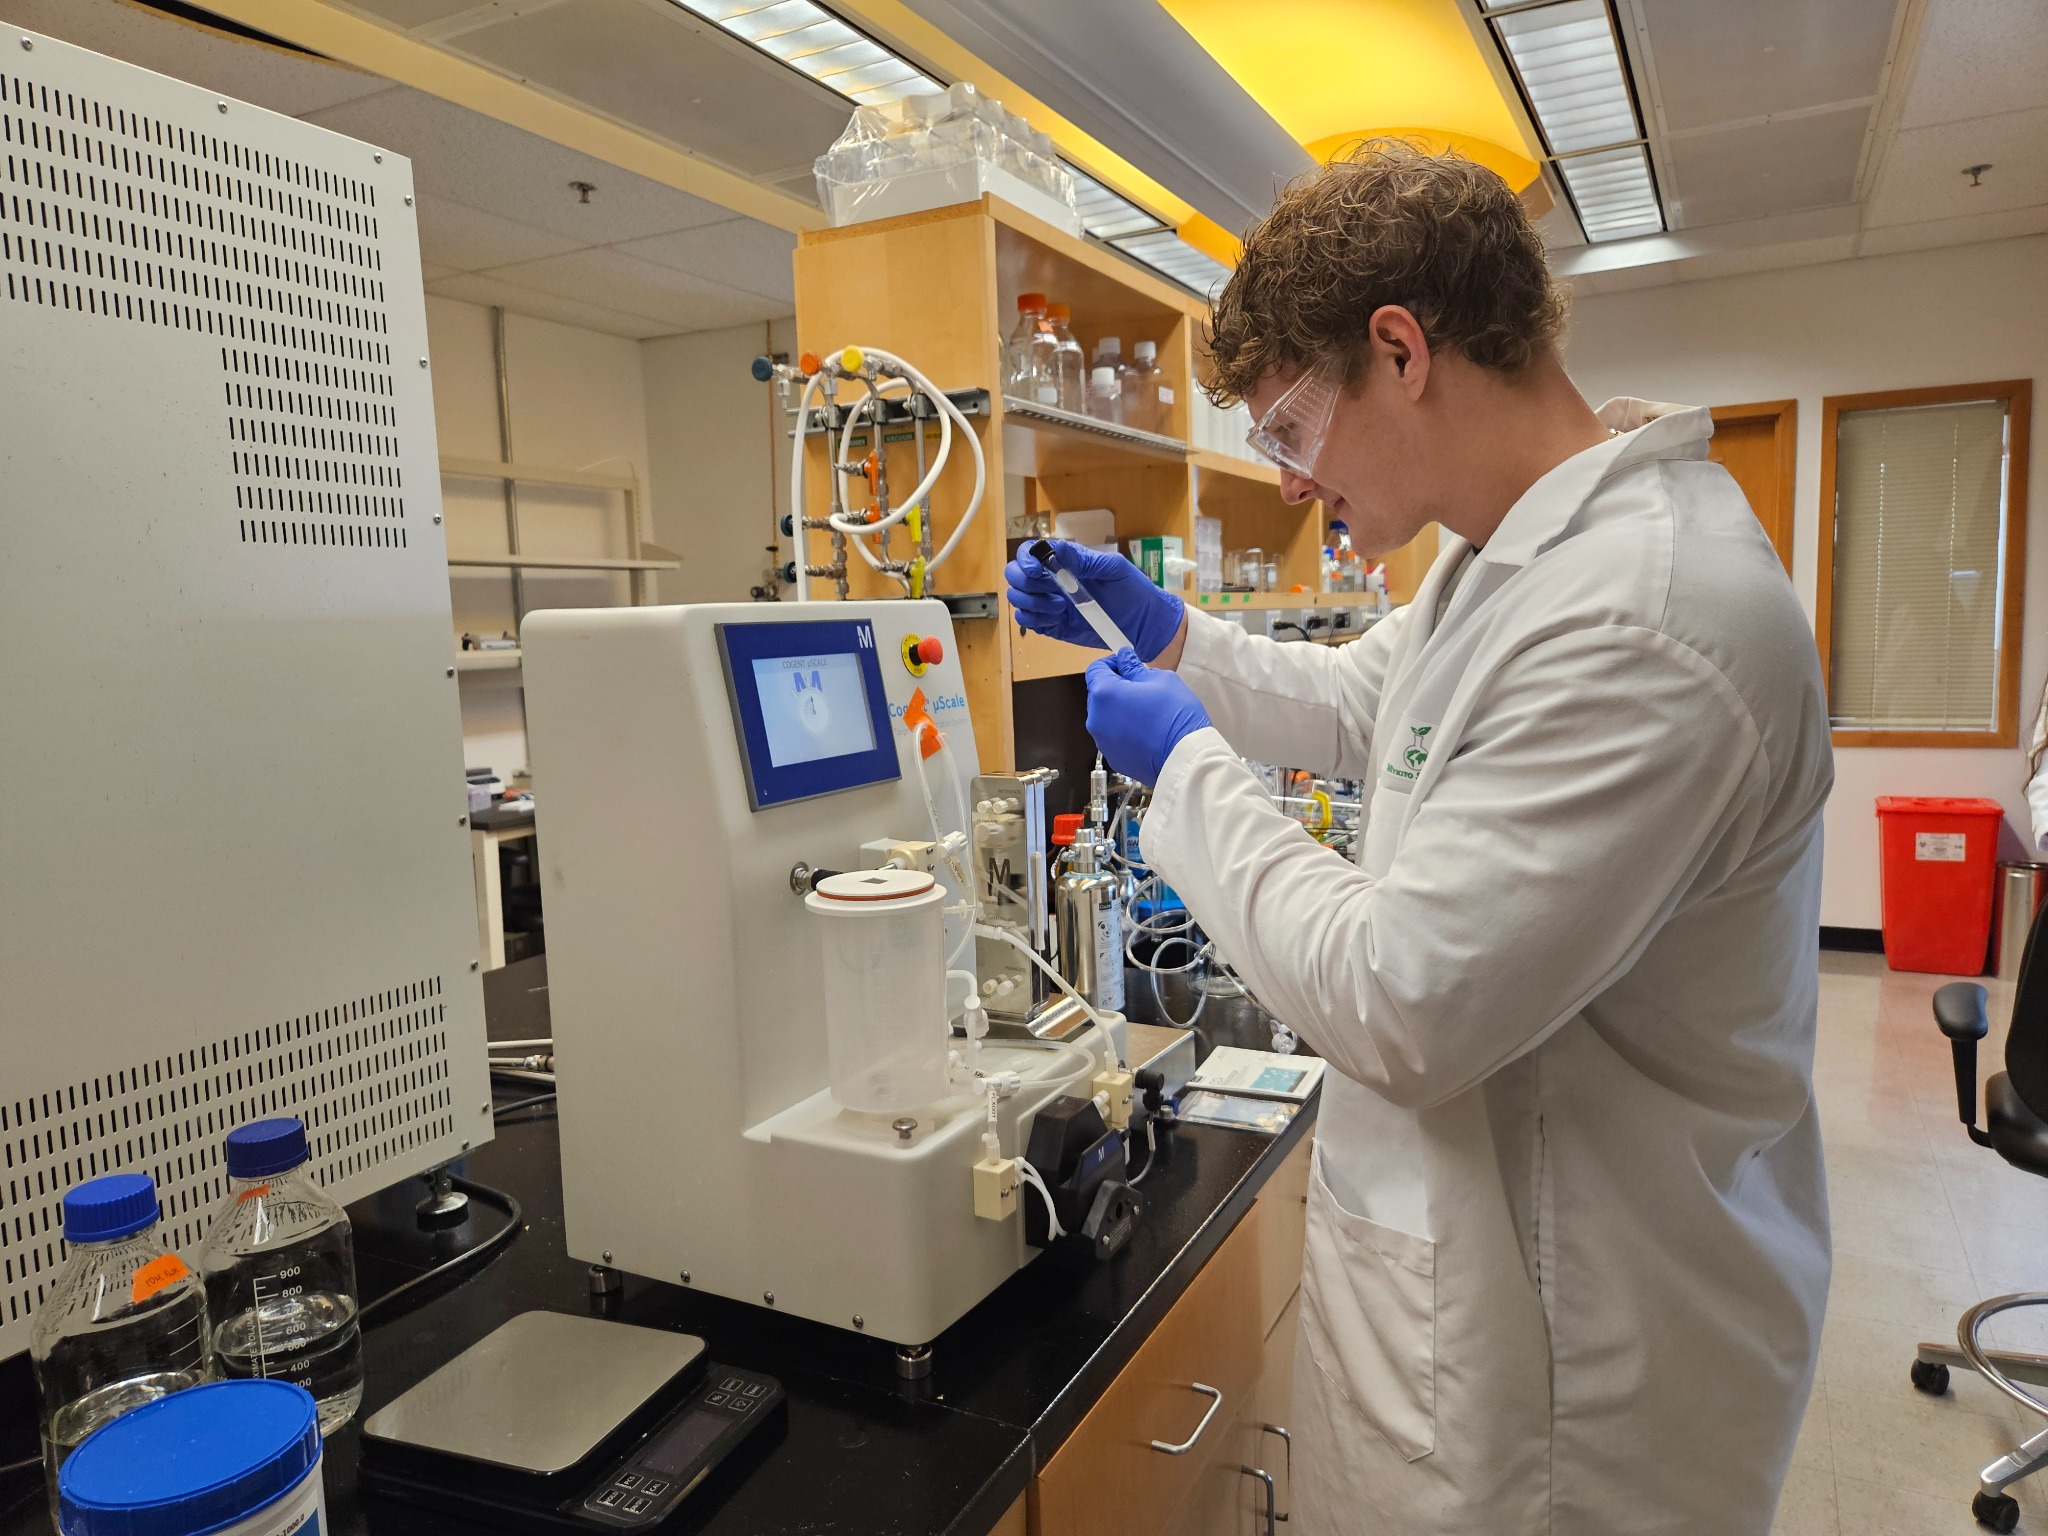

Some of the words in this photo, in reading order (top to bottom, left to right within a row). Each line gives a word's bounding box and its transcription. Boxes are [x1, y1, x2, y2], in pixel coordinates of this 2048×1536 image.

[856, 625, 873, 648] M
[782, 659, 806, 669] COGENT
[1097, 1145, 1105, 1162] M
[280, 1266, 301, 1279] 900
[282, 1285, 302, 1298] 800
[285, 1322, 306, 1335] 600
[290, 1359, 310, 1372] 400
[623, 1475, 636, 1485] PCS
[649, 1483, 661, 1492] CAL
